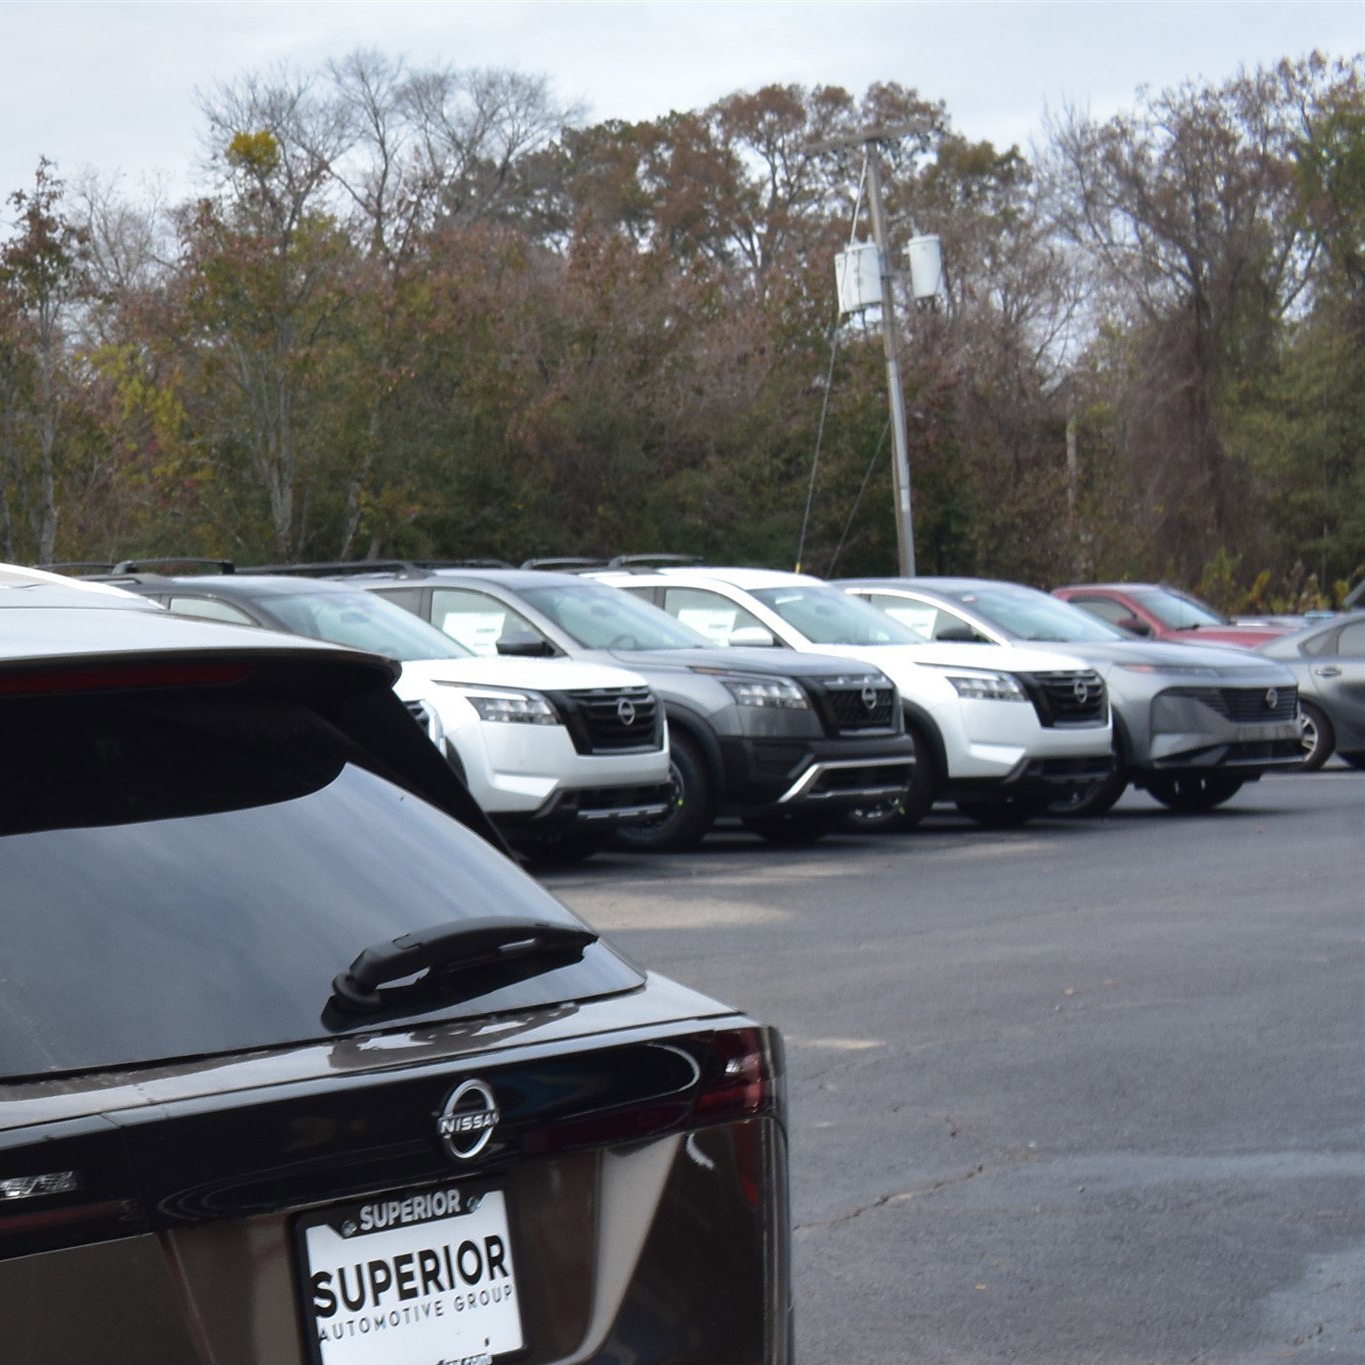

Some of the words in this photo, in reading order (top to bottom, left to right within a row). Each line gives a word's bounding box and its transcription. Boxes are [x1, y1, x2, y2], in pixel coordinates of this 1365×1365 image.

[439, 1110, 500, 1134] NISSAN
[360, 1188, 462, 1231] SUPERIOR
[310, 1234, 509, 1318] SUPERIOR
[319, 1299, 445, 1341] AUTOMOTIVE
[453, 1284, 514, 1313] GROUP
